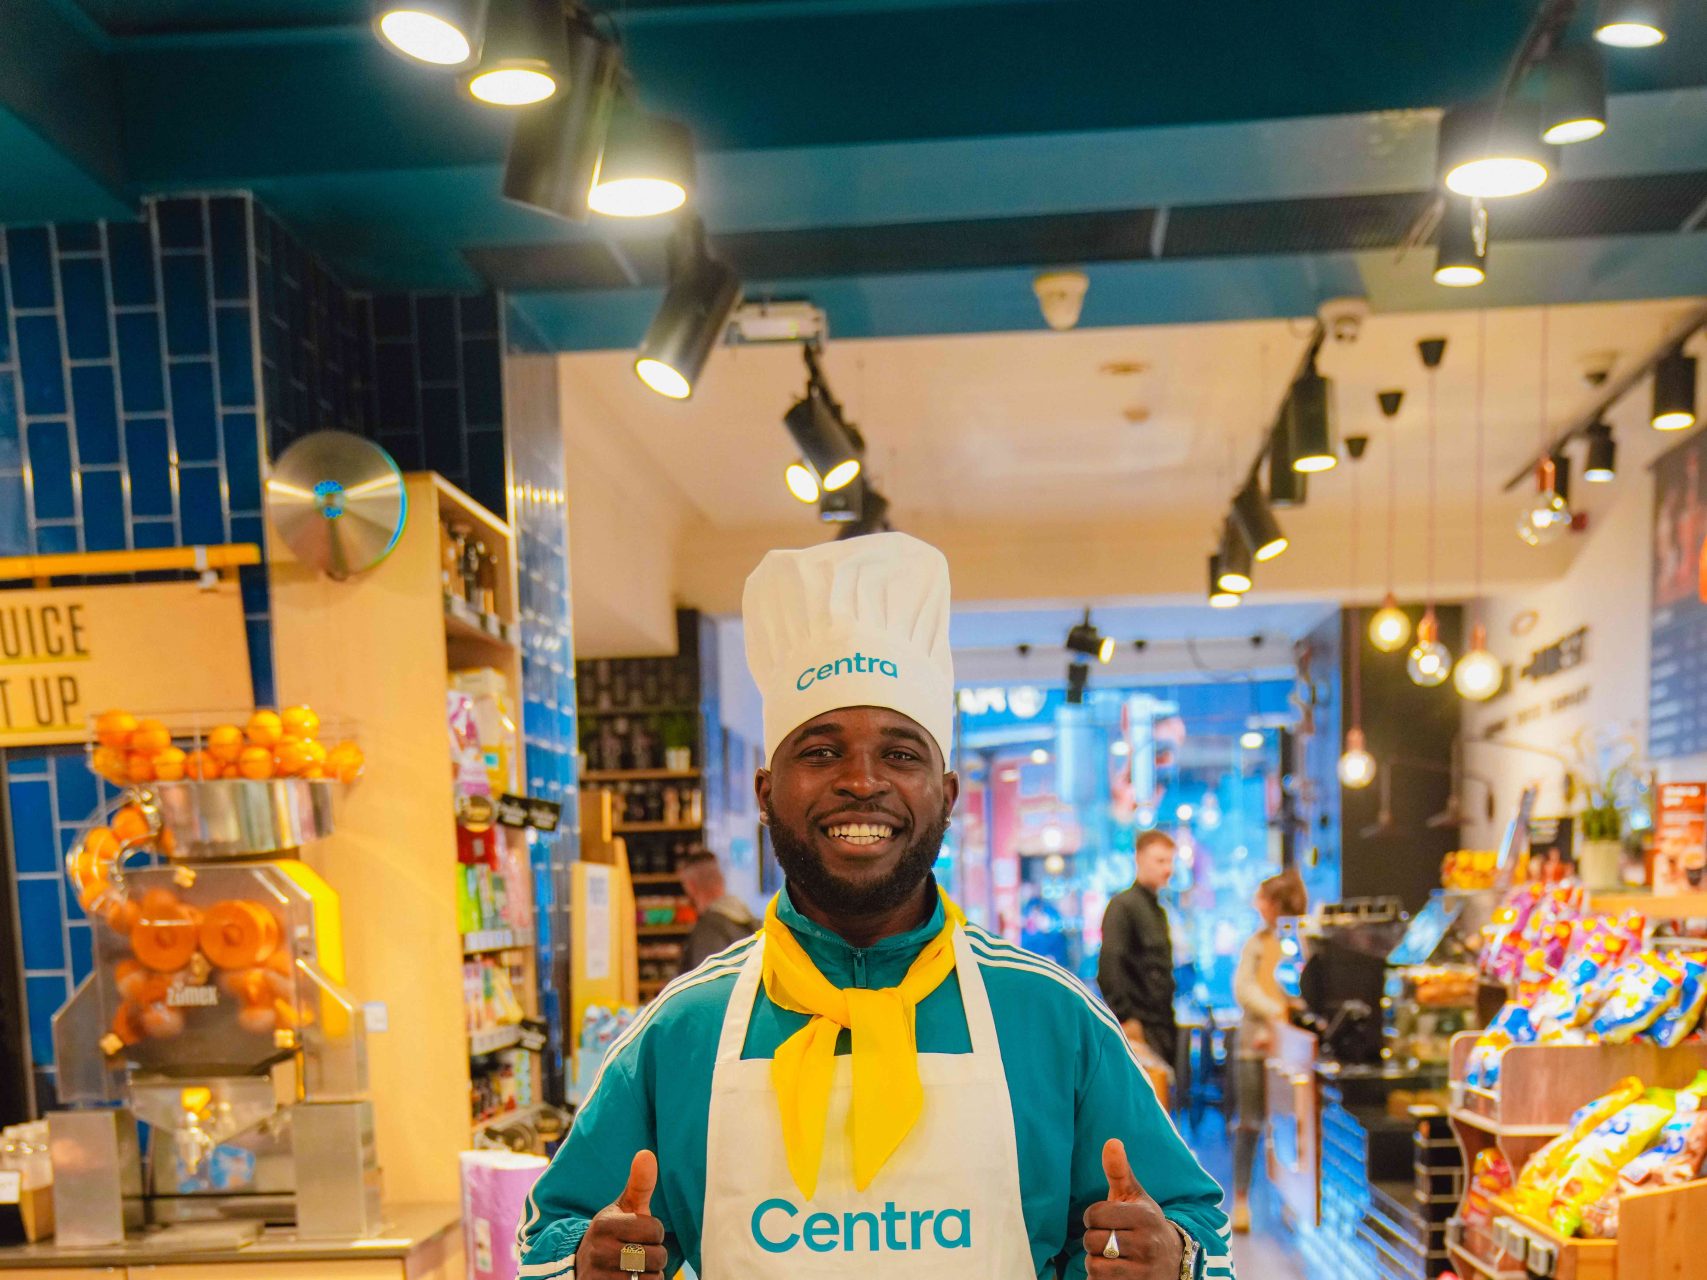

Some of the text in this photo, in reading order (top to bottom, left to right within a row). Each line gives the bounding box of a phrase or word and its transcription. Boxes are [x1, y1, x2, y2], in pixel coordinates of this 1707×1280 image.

[796, 652, 898, 691] Centra
[29, 675, 79, 727] UP
[751, 1198, 971, 1253] Centra
